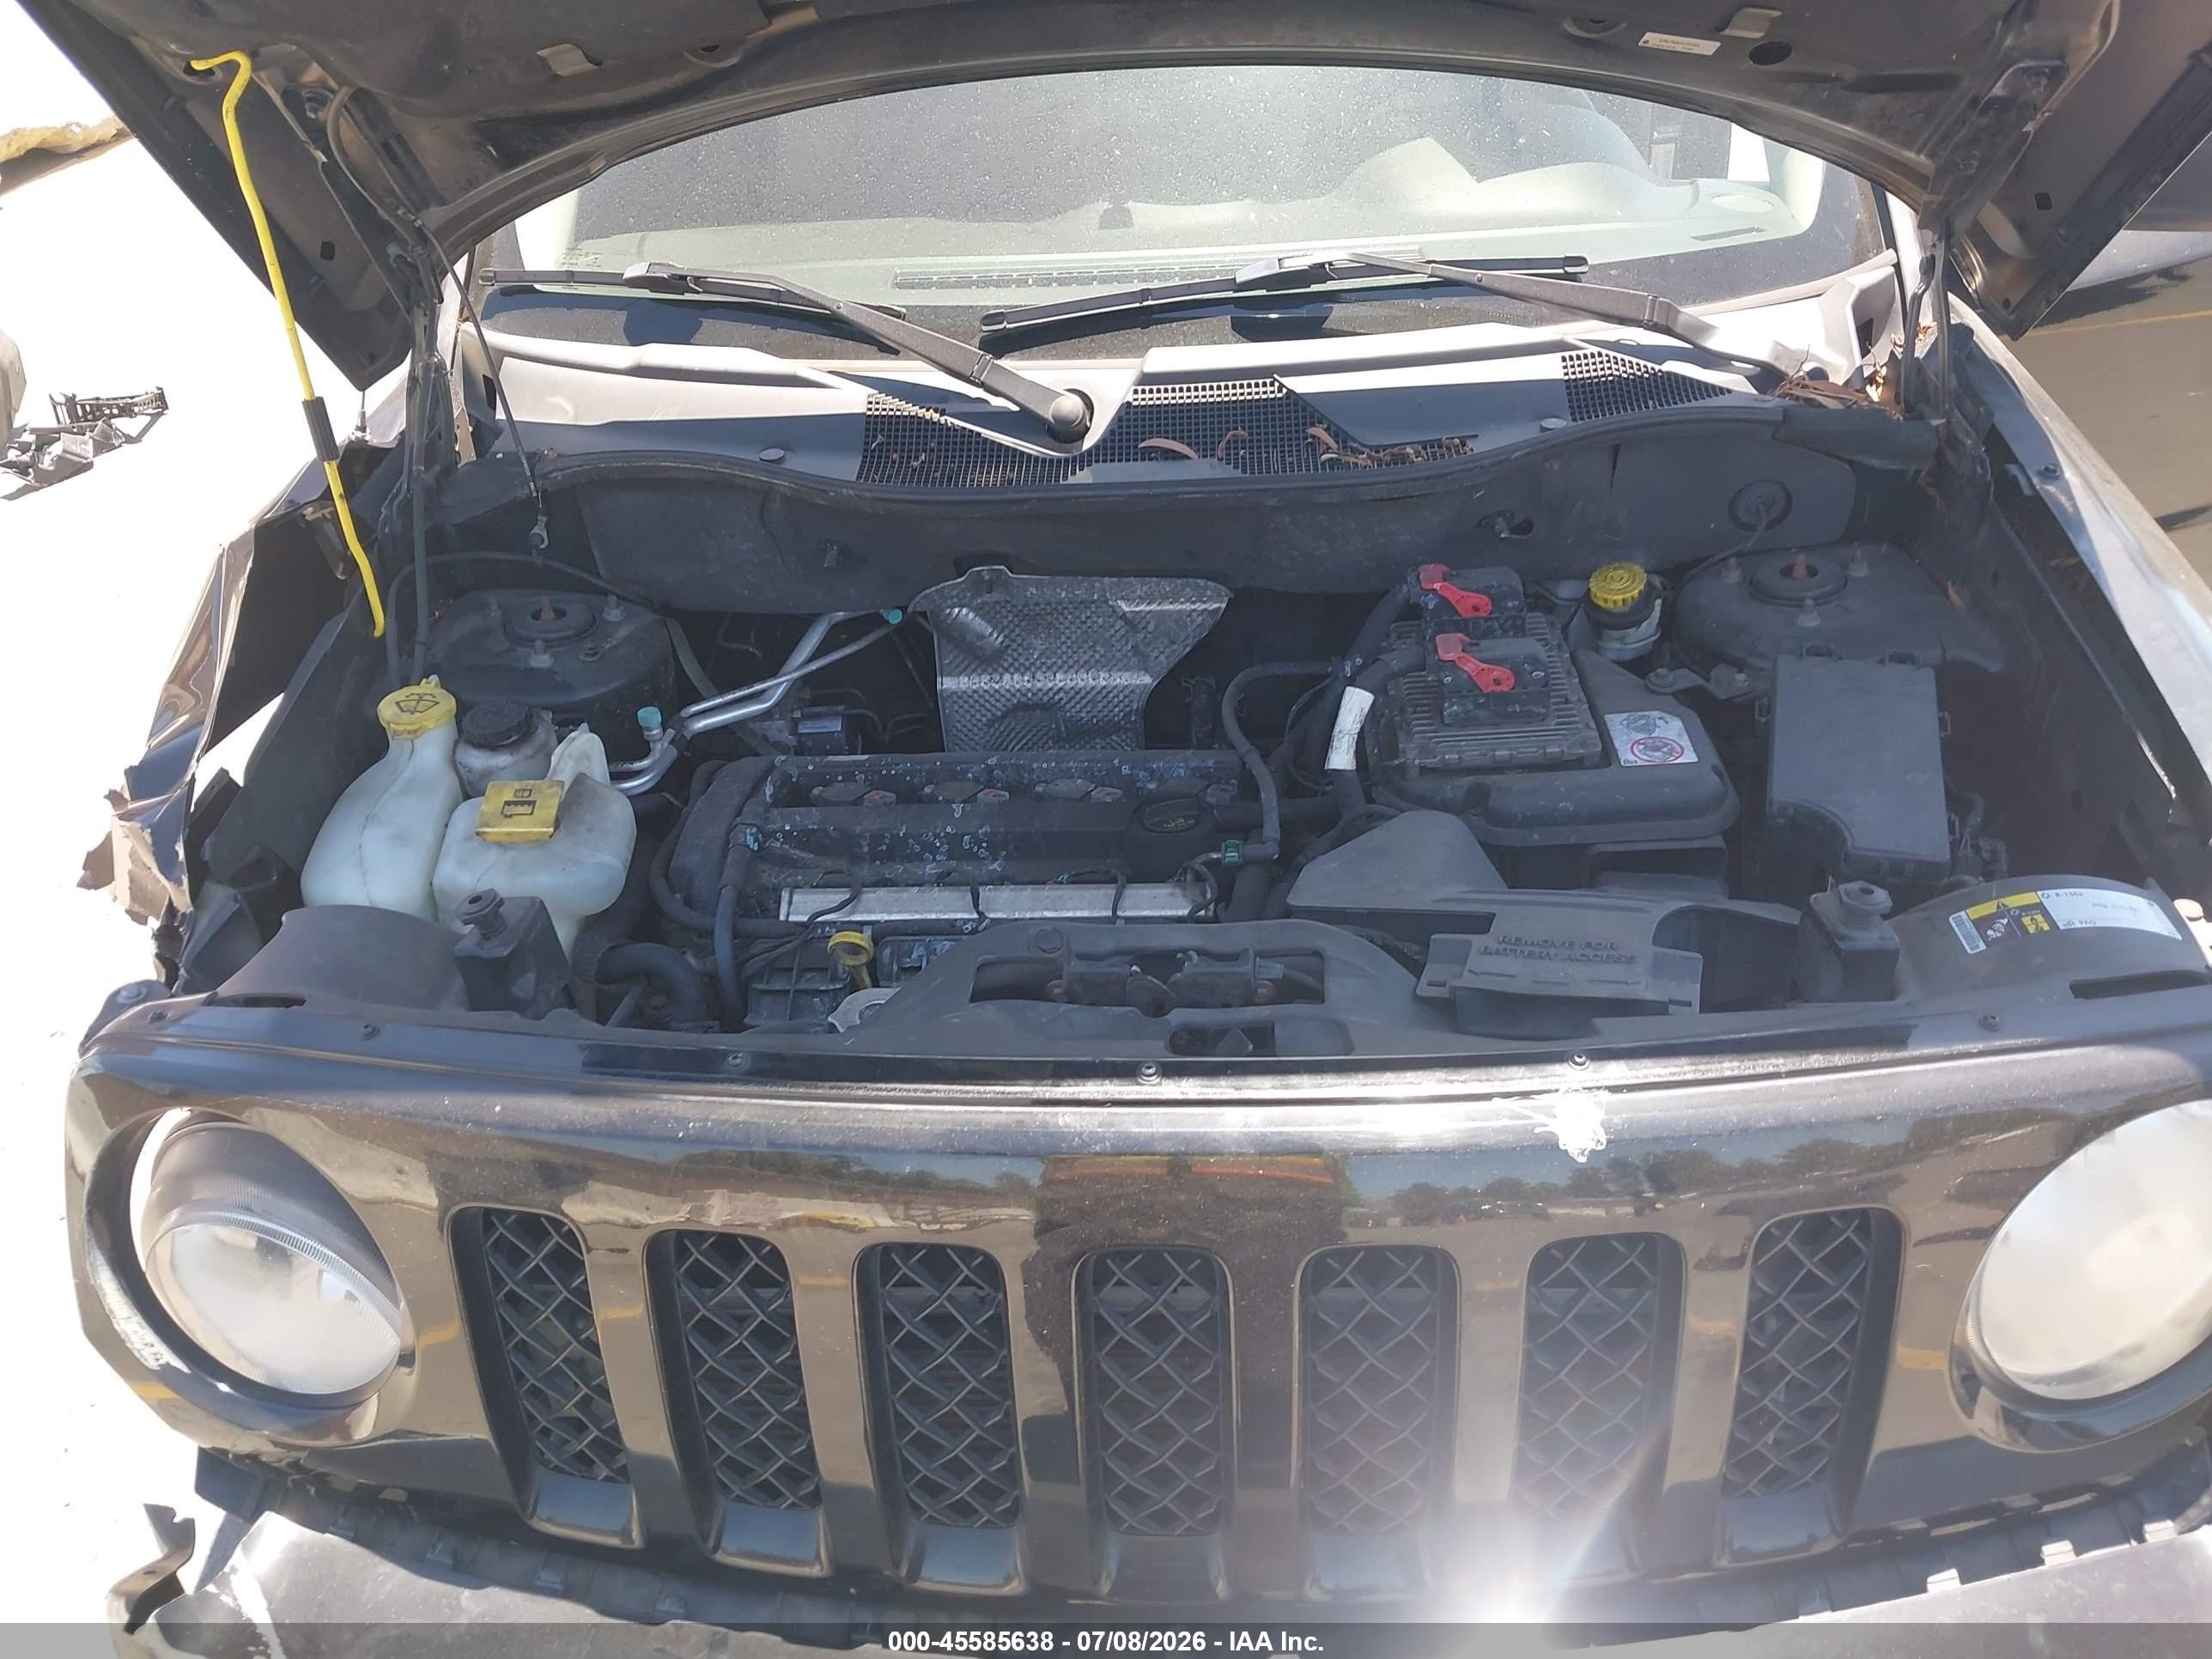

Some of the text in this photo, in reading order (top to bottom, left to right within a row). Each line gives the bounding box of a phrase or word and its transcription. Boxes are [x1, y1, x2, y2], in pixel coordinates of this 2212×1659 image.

[1499, 935, 1619, 951] REMOVE FOR
[1479, 945, 1638, 964] BATTERY ACCESS
